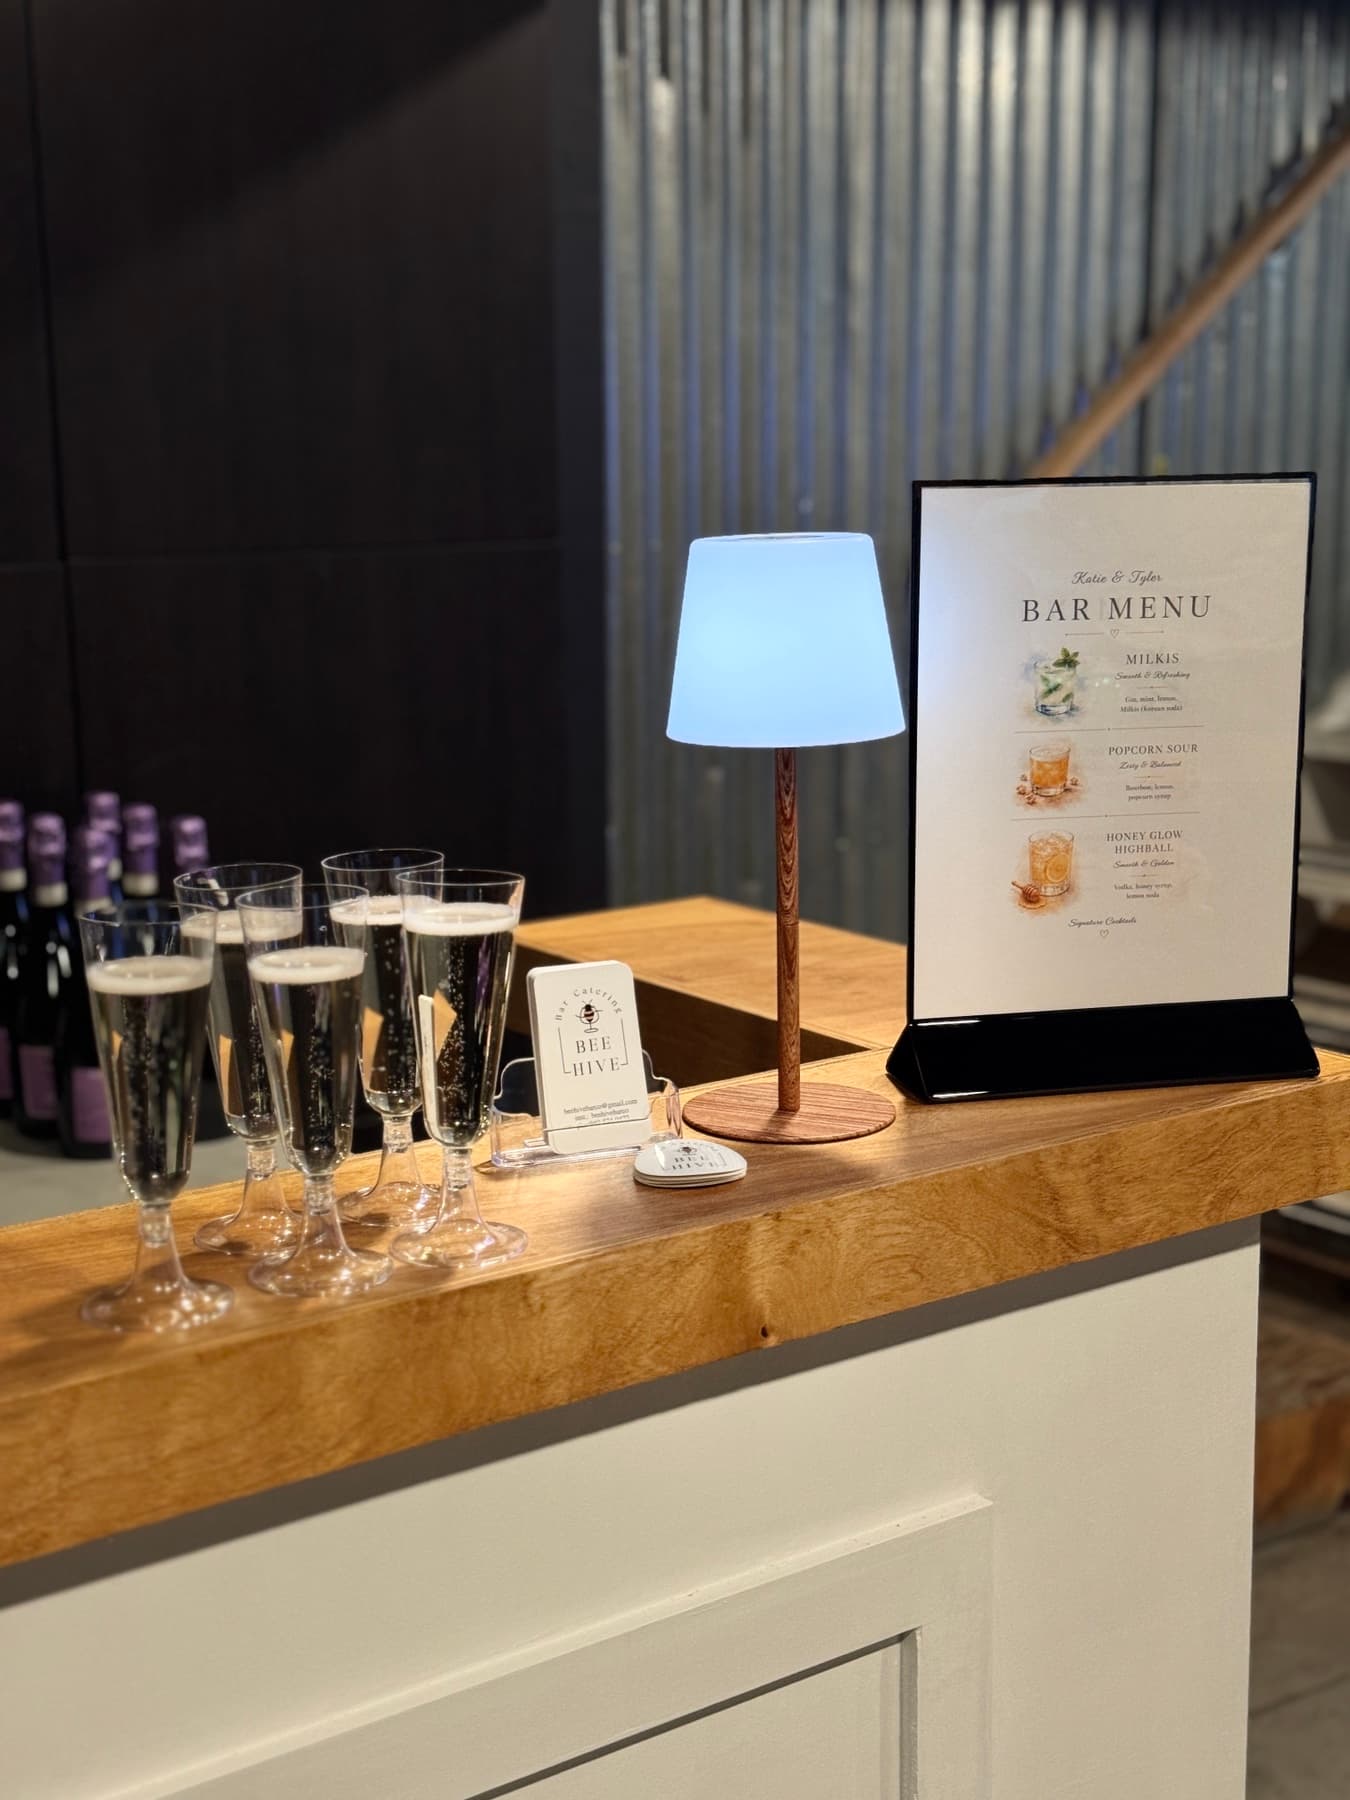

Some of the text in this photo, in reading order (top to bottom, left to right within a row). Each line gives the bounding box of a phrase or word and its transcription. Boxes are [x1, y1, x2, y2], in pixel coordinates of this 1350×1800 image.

[1072, 569, 1163, 587] Katie & Tyler
[1022, 595, 1212, 622] BAR MENU
[1126, 653, 1180, 665] MILKIS
[1109, 744, 1198, 755] POPCORN SOUR
[1107, 830, 1183, 842] HONEY GLOW
[1115, 844, 1173, 854] HIGHBALL
[1068, 918, 1103, 928] Signature
[576, 1036, 612, 1054] BEE
[573, 1057, 620, 1076] HIVE
